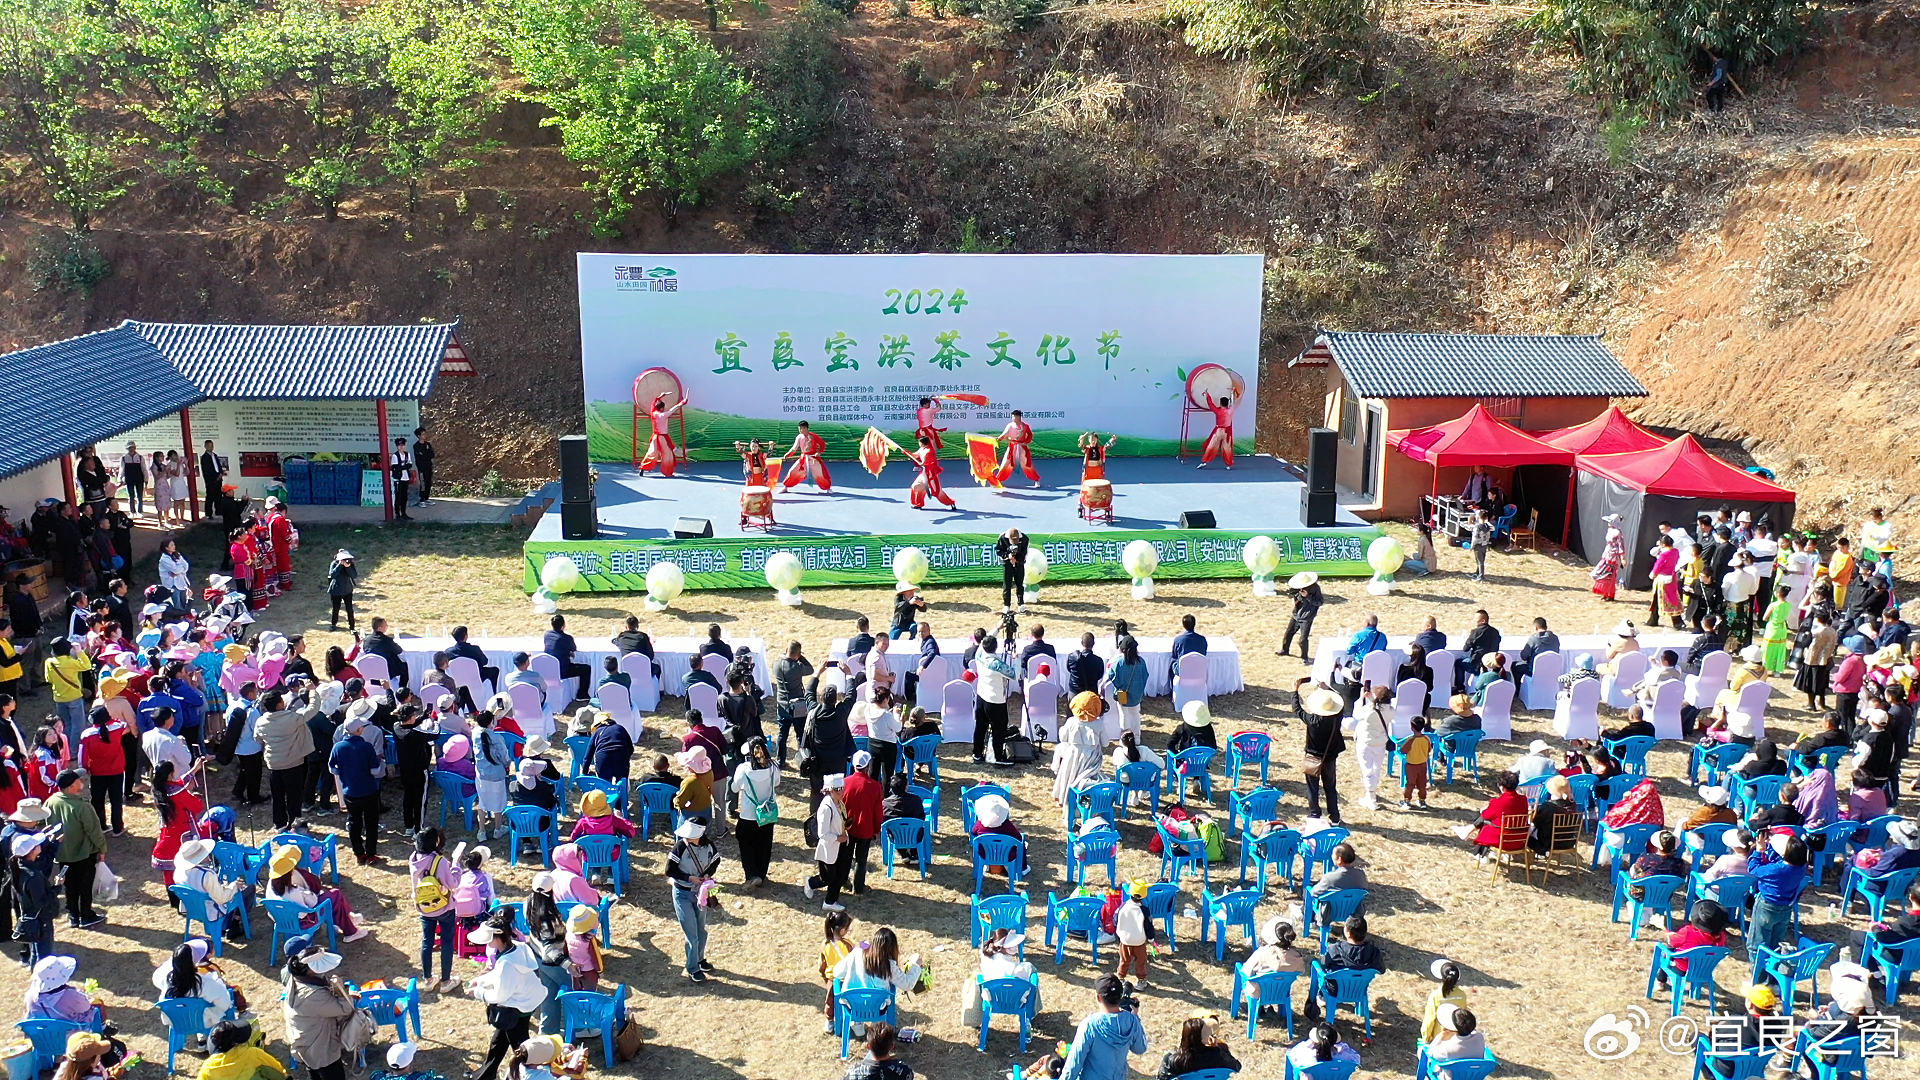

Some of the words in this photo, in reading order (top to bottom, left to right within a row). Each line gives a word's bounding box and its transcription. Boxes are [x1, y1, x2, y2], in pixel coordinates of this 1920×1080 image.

[881, 288, 969, 315] 2024
[711, 329, 1123, 374] 宜良宝洪茶文化节
[818, 413, 875, 422] 宜良县融媒体中心
[884, 412, 967, 421] 云南宝洪旅发有限公司
[870, 403, 920, 412] 宜良县农业农村
[740, 545, 867, 571] 宜良风情庆典公司
[1302, 536, 1363, 560] 傲雪紫米露
